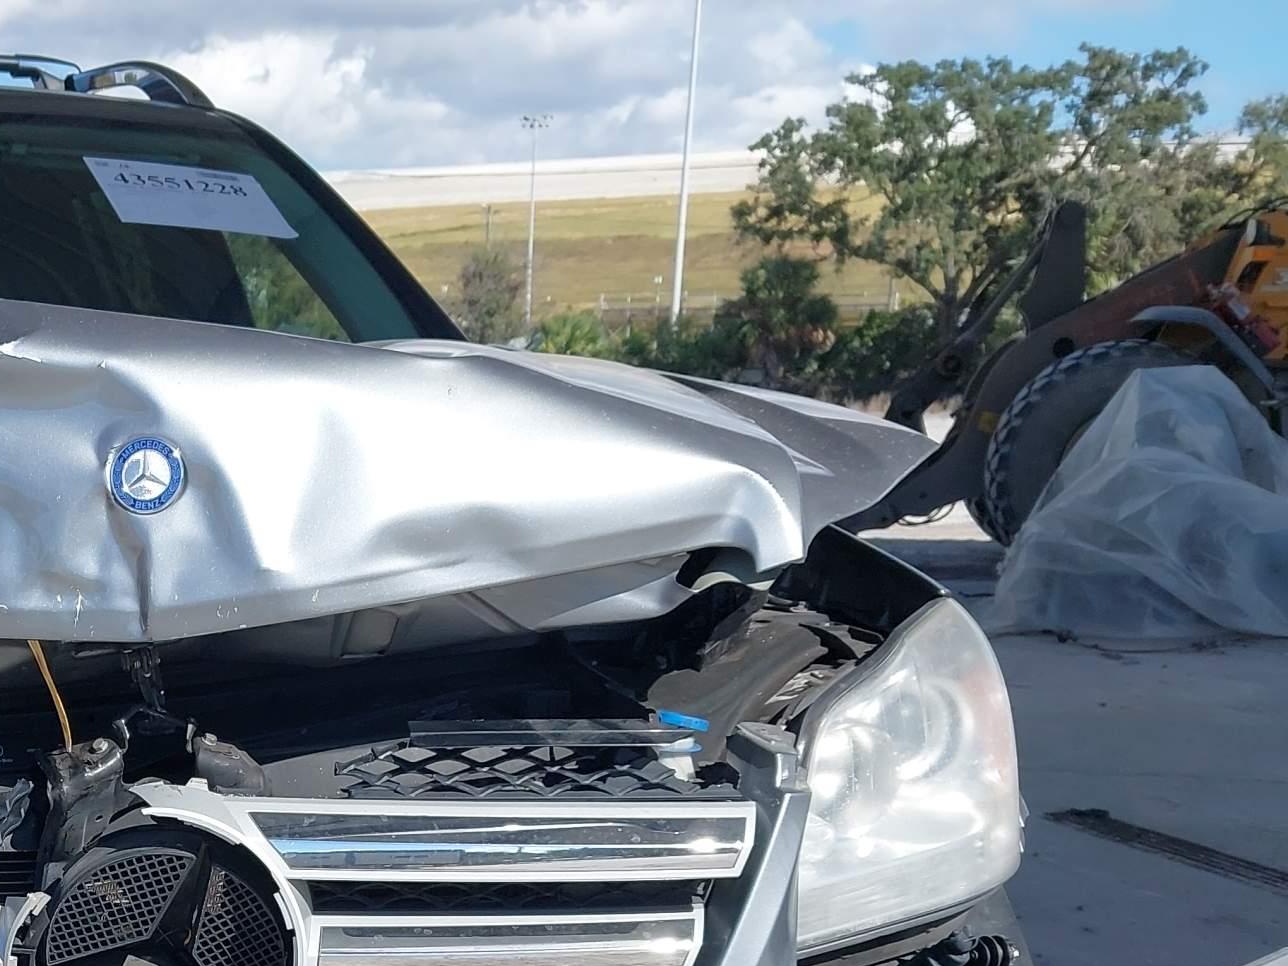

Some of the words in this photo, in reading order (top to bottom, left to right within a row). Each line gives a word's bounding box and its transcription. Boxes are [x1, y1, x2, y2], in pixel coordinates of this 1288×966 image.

[114, 172, 248, 196] 43551228
[121, 440, 171, 459] MERCEDES
[134, 500, 161, 510] BENZ
